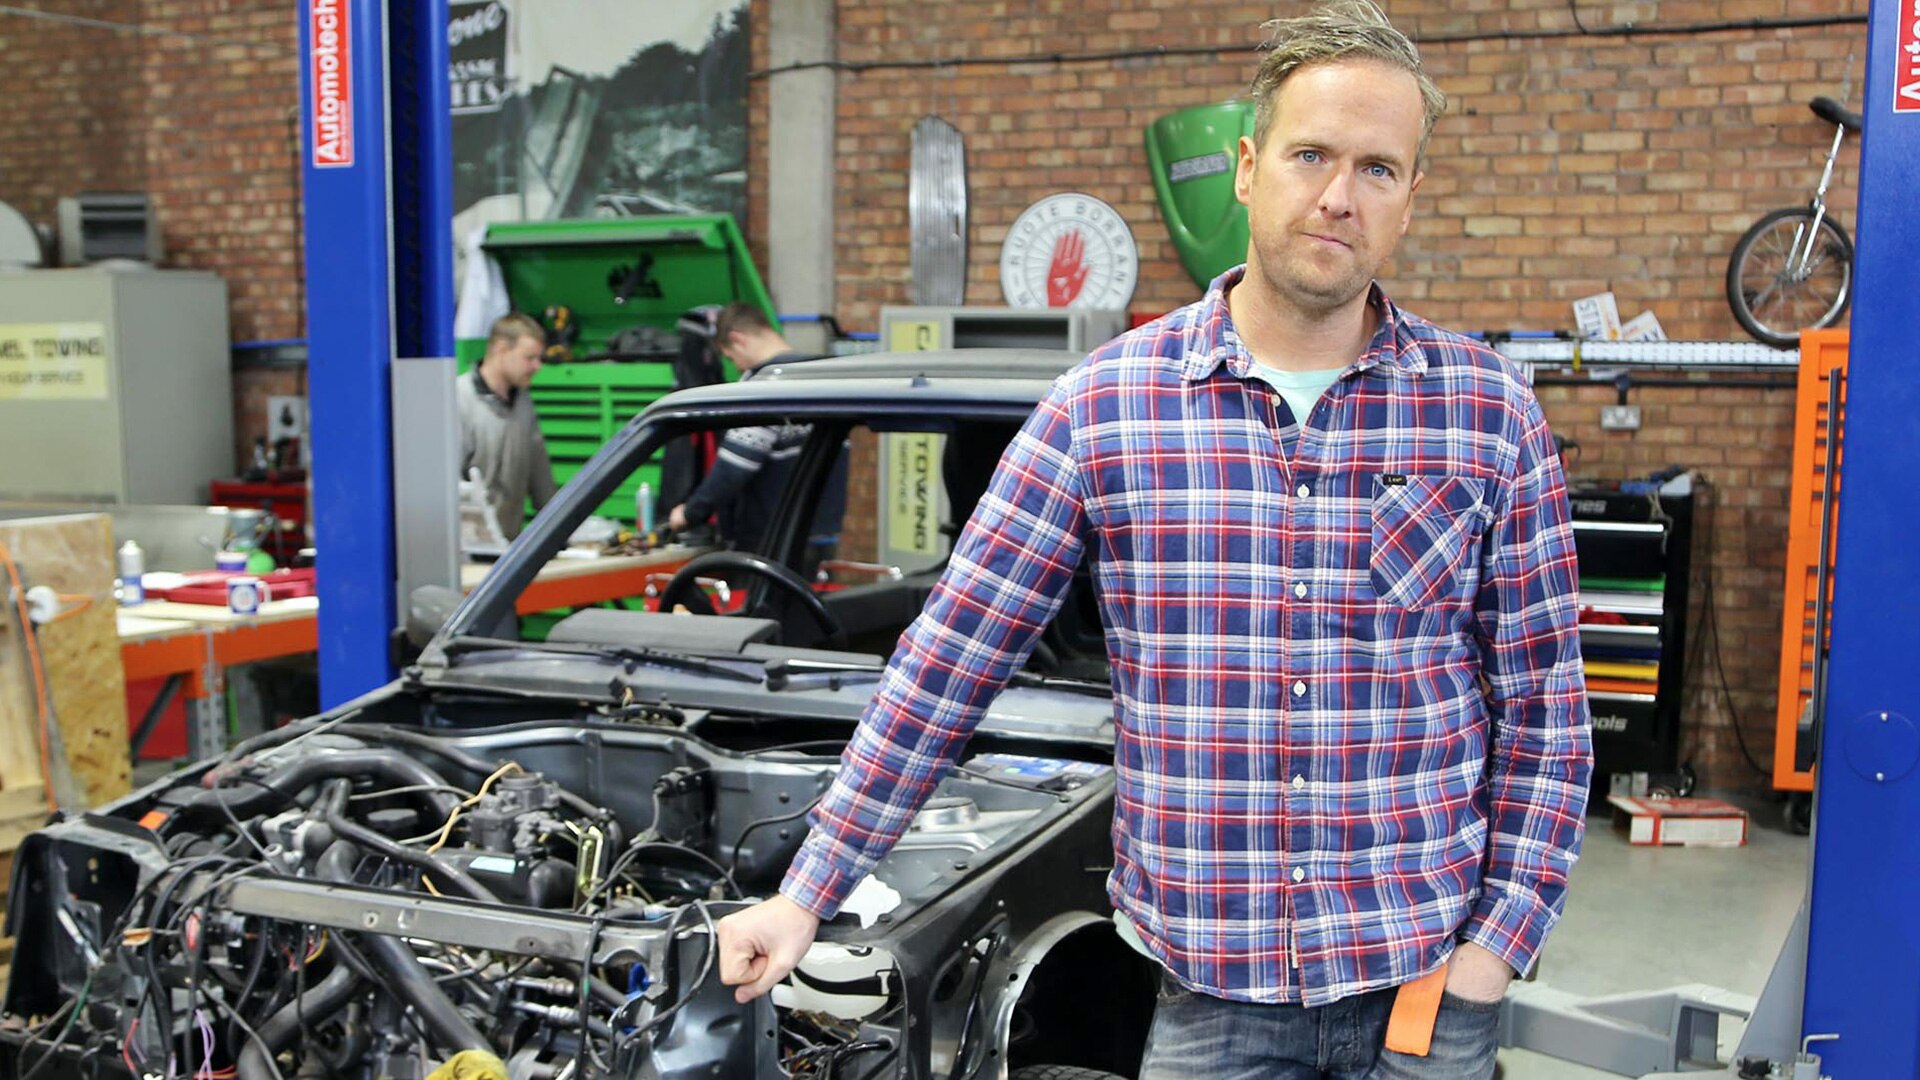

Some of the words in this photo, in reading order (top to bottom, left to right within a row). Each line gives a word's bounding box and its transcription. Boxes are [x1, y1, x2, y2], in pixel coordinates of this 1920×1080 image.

[312, 0, 342, 161] Automotech
[1010, 202, 1060, 266] RUOTE
[914, 439, 930, 550] TOWING
